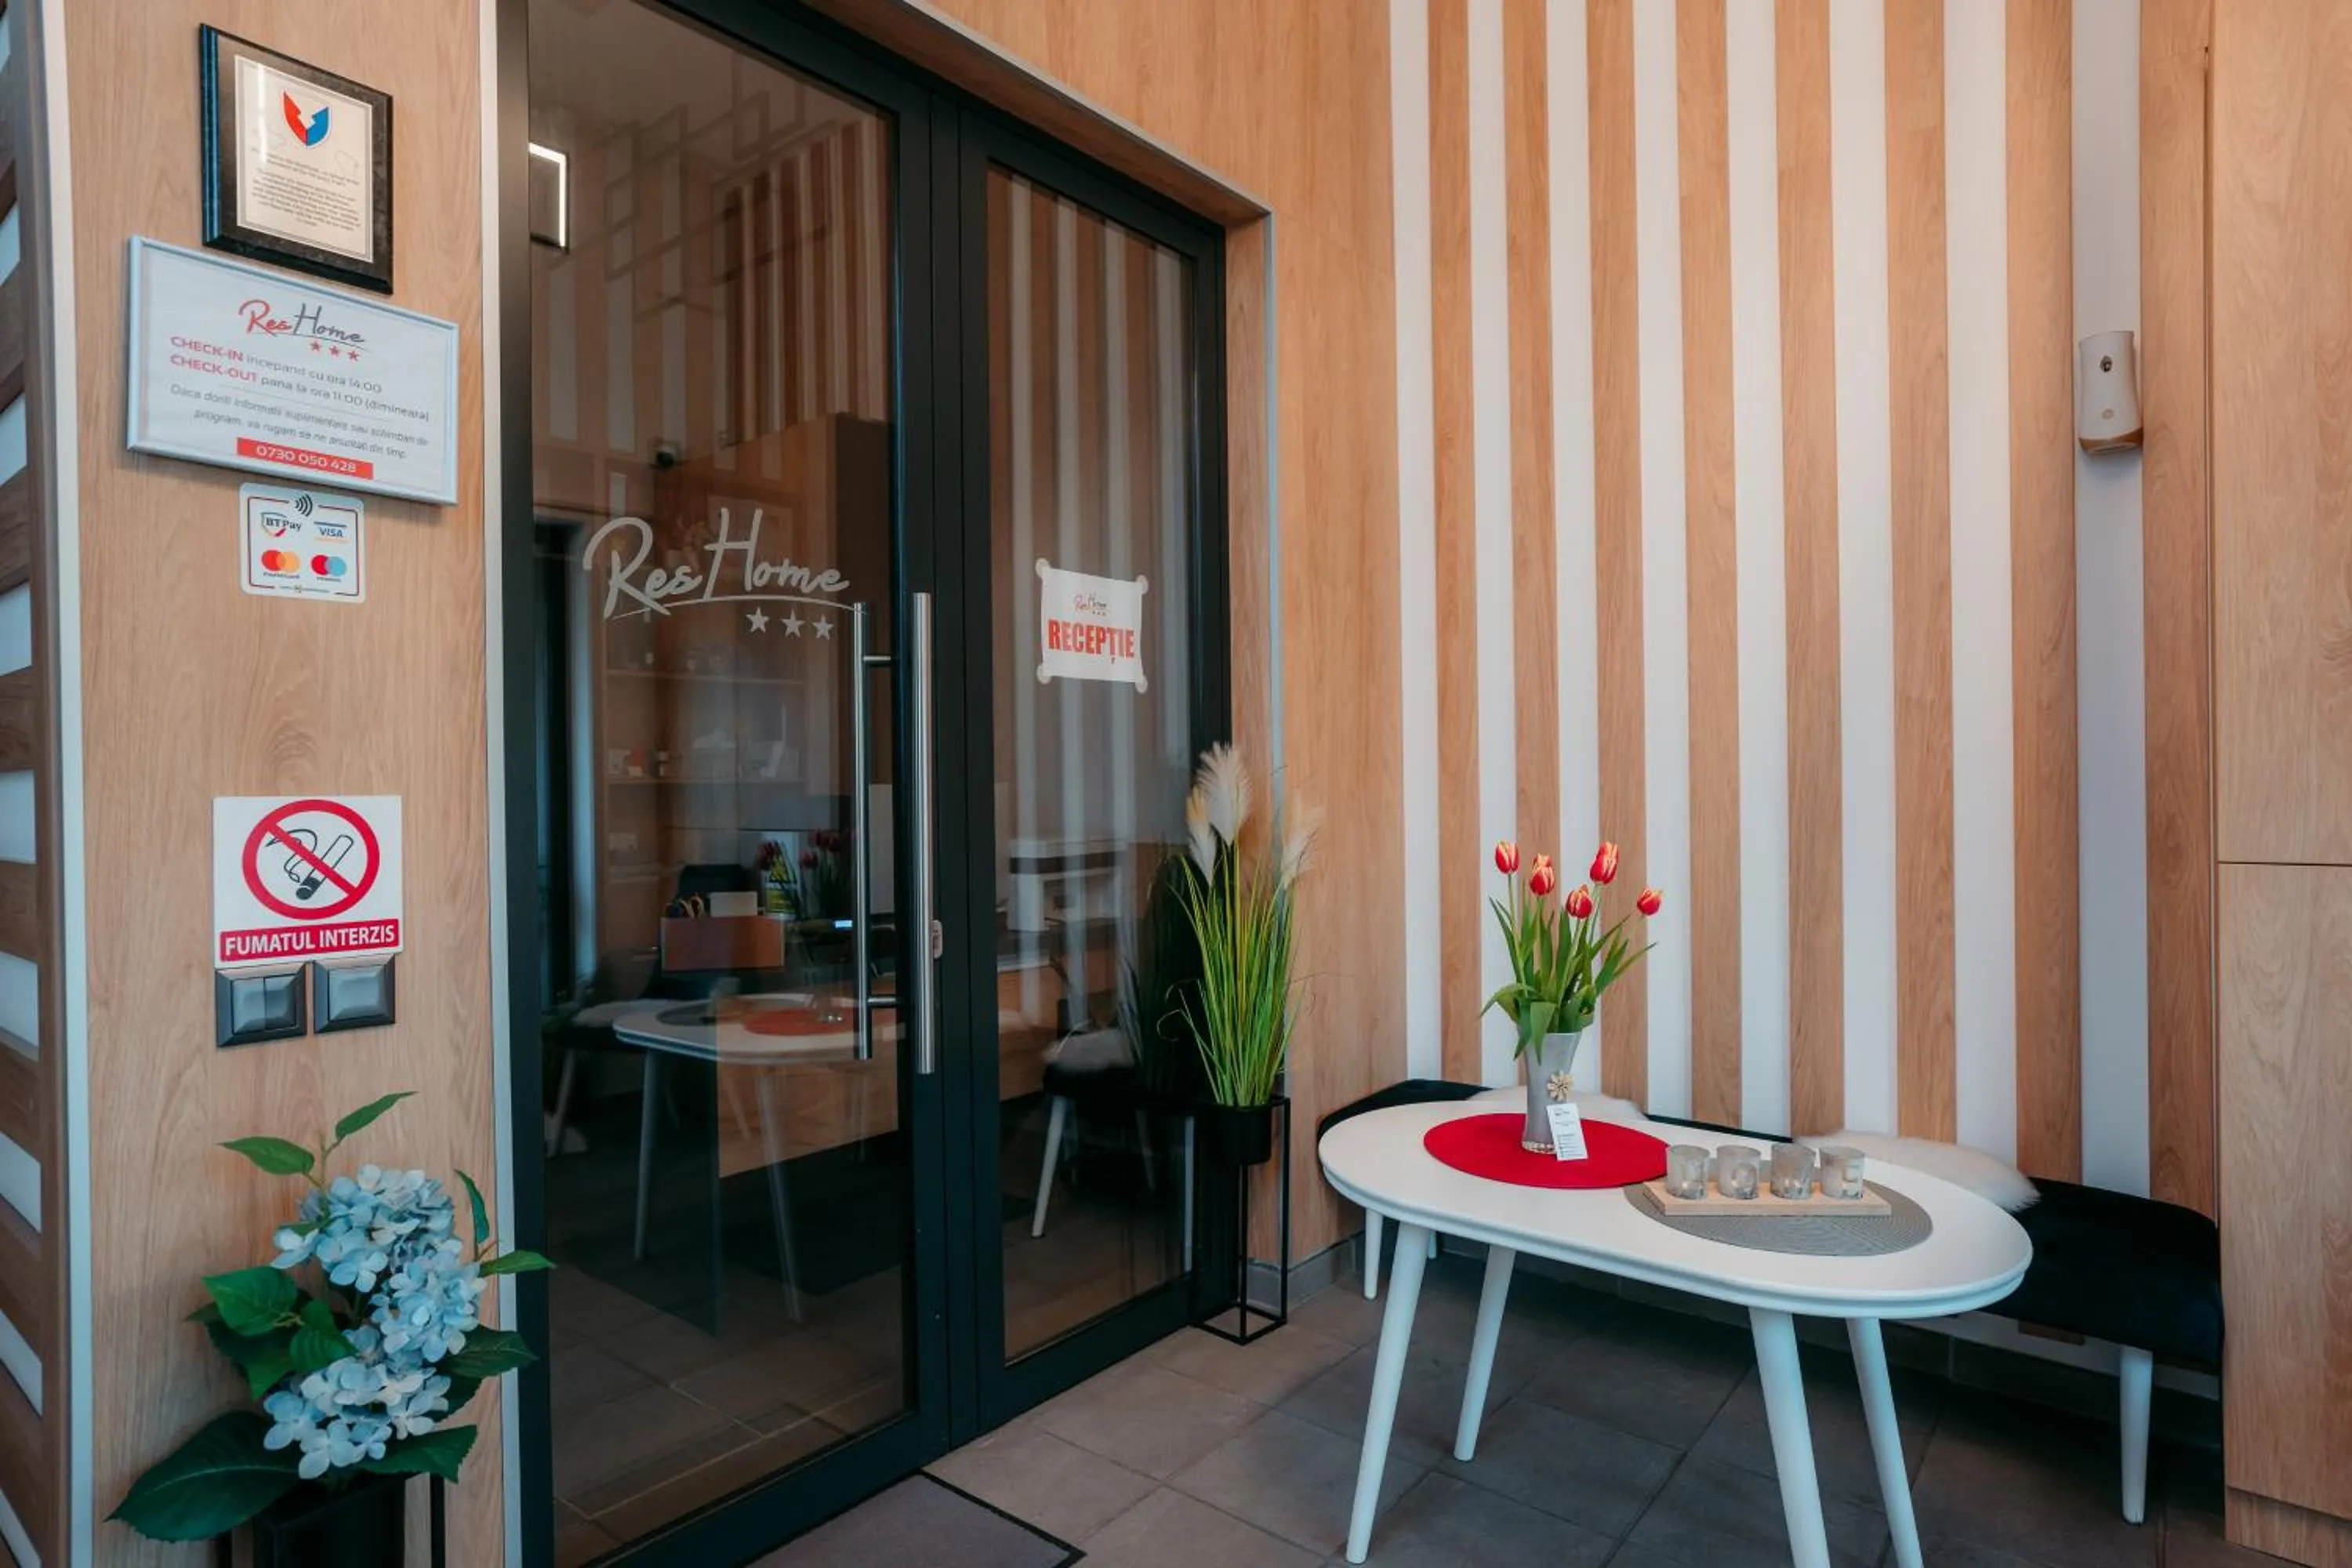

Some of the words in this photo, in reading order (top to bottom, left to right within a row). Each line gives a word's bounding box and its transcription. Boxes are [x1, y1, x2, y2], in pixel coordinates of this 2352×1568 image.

[170, 336, 244, 362] CHECK-IN
[247, 354, 306, 376] incepand
[309, 370, 324, 381] cu
[326, 374, 347, 386] ora
[170, 354, 258, 383] CHECK-OUT
[261, 376, 293, 391] pana
[296, 383, 307, 393] la
[310, 387, 331, 400] ora
[256, 445, 296, 462] 0730
[298, 453, 328, 468] 050
[330, 459, 357, 474] 428
[318, 527, 344, 538] VISA
[225, 931, 315, 956] FUMATUL
[319, 924, 395, 949] INTERZIS
